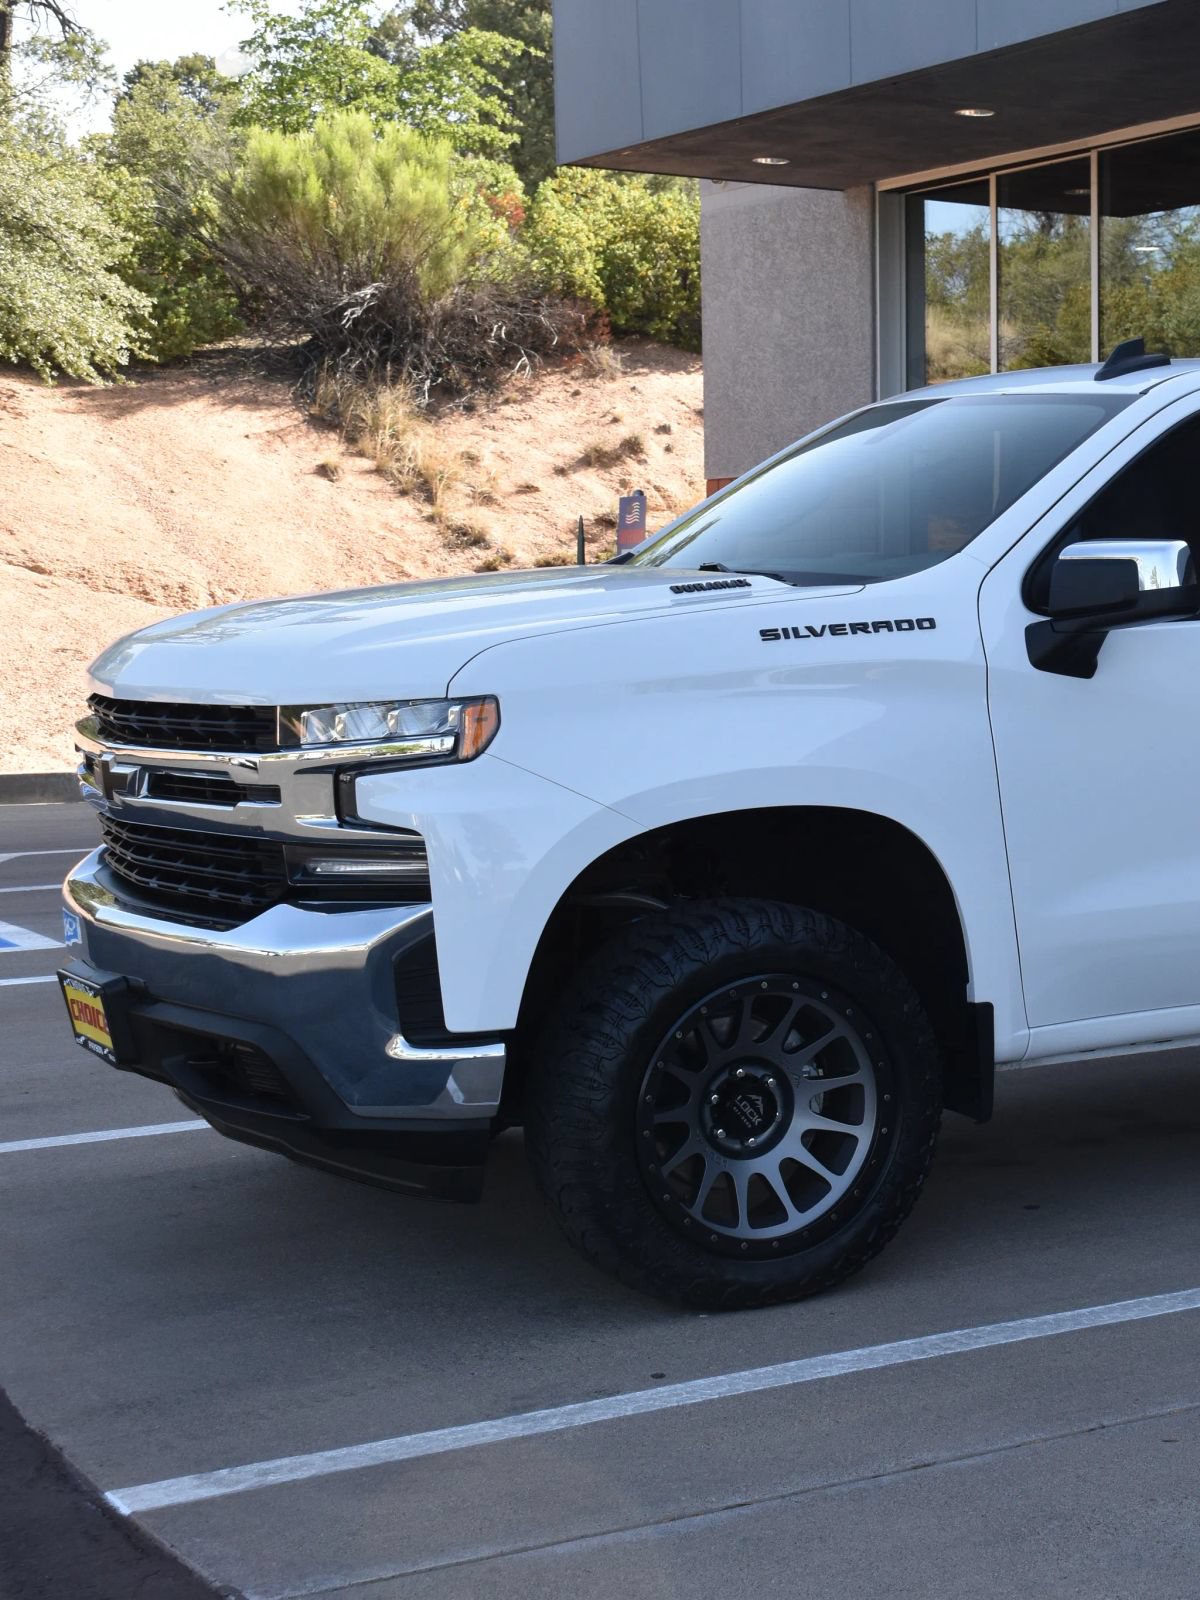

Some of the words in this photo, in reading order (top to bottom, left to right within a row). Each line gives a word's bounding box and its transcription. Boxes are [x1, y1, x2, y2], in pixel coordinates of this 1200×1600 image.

[669, 579, 752, 594] DURAMAX
[759, 617, 937, 642] SILVERADO
[735, 1094, 763, 1127] LOCK
